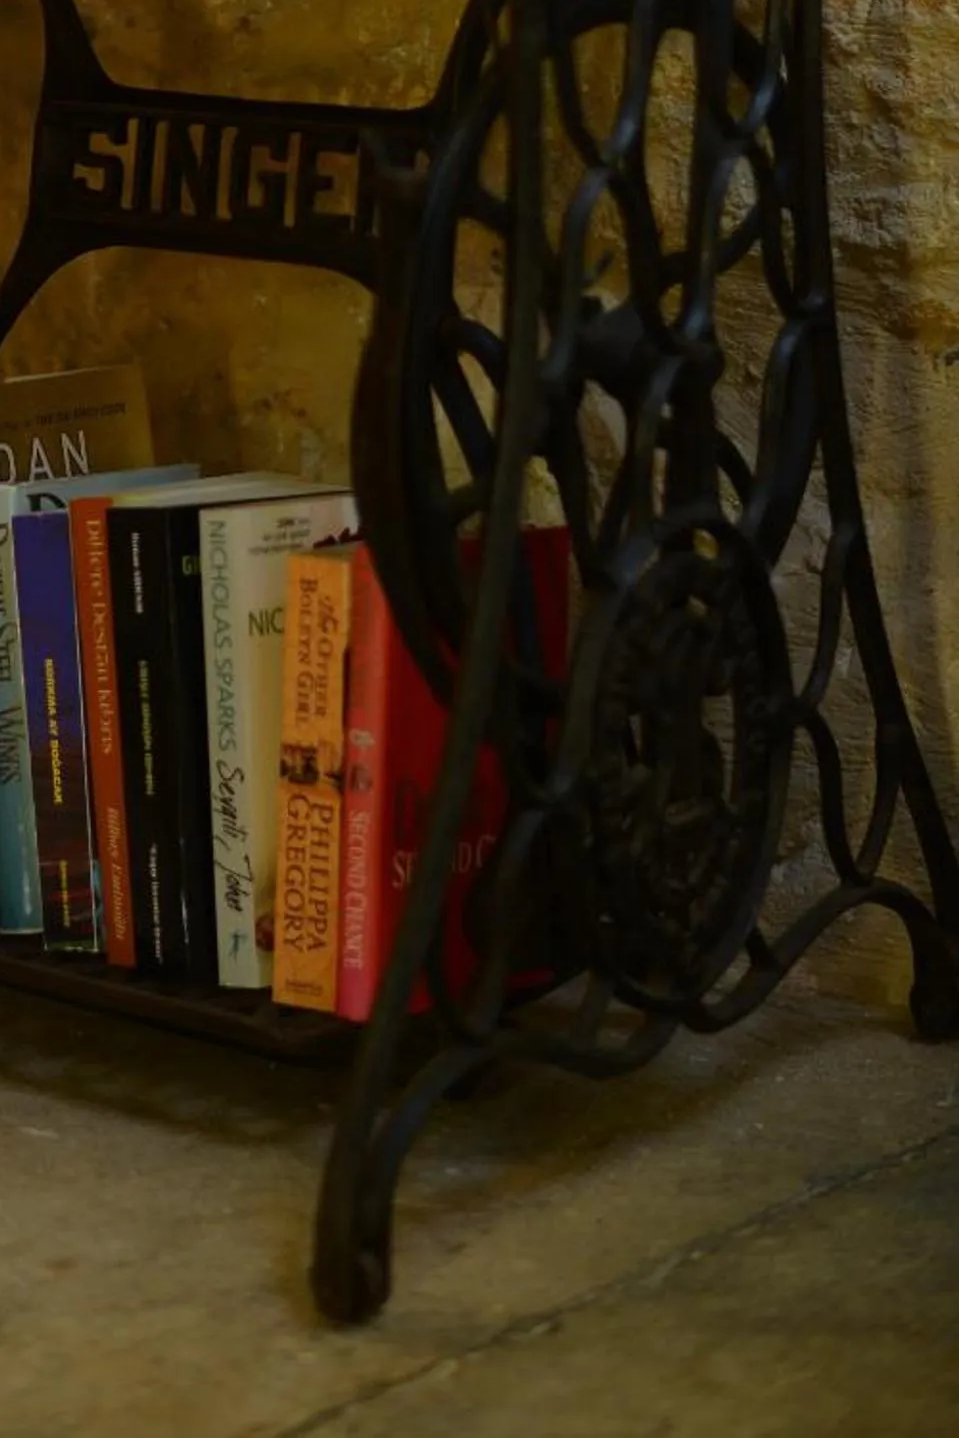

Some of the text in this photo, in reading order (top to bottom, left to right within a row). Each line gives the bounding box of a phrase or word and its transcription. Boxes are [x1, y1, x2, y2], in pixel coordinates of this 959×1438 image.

[206, 520, 237, 752] NICHOLAS SPARKS
[283, 792, 312, 953] GREGORY
[307, 802, 335, 952] PHILIPPA
